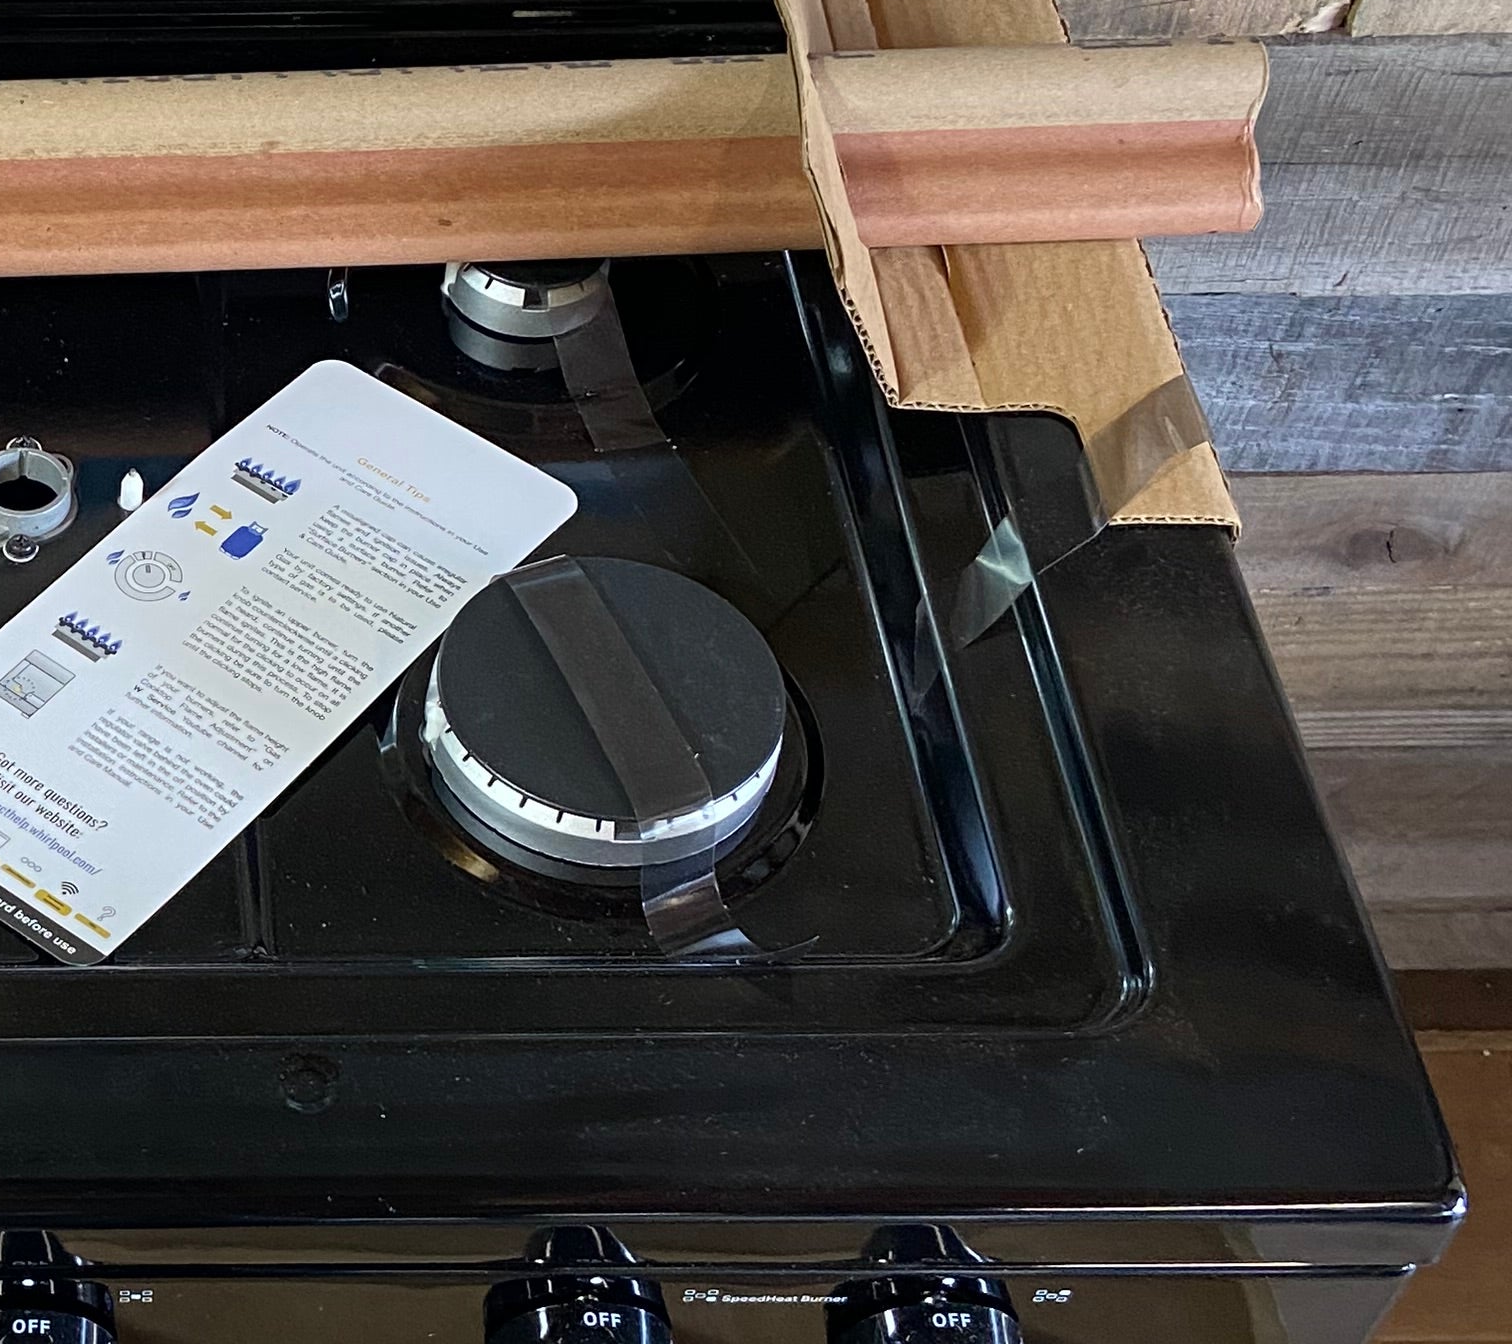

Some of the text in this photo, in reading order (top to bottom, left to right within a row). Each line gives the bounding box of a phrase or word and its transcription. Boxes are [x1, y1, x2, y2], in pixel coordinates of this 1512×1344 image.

[356, 457, 431, 504] General Tips
[181, 639, 263, 694] until the clicking stops.
[195, 625, 333, 714] burners during this process. To stop
[202, 619, 342, 708] normal for the clicking to occur on all
[210, 612, 244, 636] continue
[243, 632, 271, 653] turning
[270, 649, 284, 660] for
[290, 661, 307, 674] low
[306, 671, 329, 691] flame.
[330, 687, 340, 695] It
[338, 692, 348, 701] is
[217, 605, 353, 694] flame ignites. This is the high flame,
[224, 598, 362, 687] is heard, continue turning until the
[231, 591, 253, 608] knob
[314, 643, 334, 657] until
[338, 659, 369, 681] clicking
[239, 585, 375, 672] To ignite an upper burner, turn the
[146, 671, 282, 760] of your burners, refer to "Gas
[154, 663, 291, 754] If you want to adjust the flame height
[188, 632, 328, 721] the clicking be sure to turn the knob
[133, 684, 265, 772] W Service Youtube channel for
[139, 677, 174, 702] Cooktop
[178, 701, 204, 722] Flame
[262, 757, 275, 768] on
[12, 767, 45, 792] more
[43, 788, 109, 832] questions?
[13, 790, 37, 807] our
[34, 803, 84, 839] website:
[13, 909, 53, 939] before
[52, 936, 77, 955] use
[11, 1318, 51, 1334] OFF
[583, 1311, 621, 1328] OFF
[721, 1294, 849, 1304] SpeedHeat Burner
[932, 1313, 971, 1328] OFF
